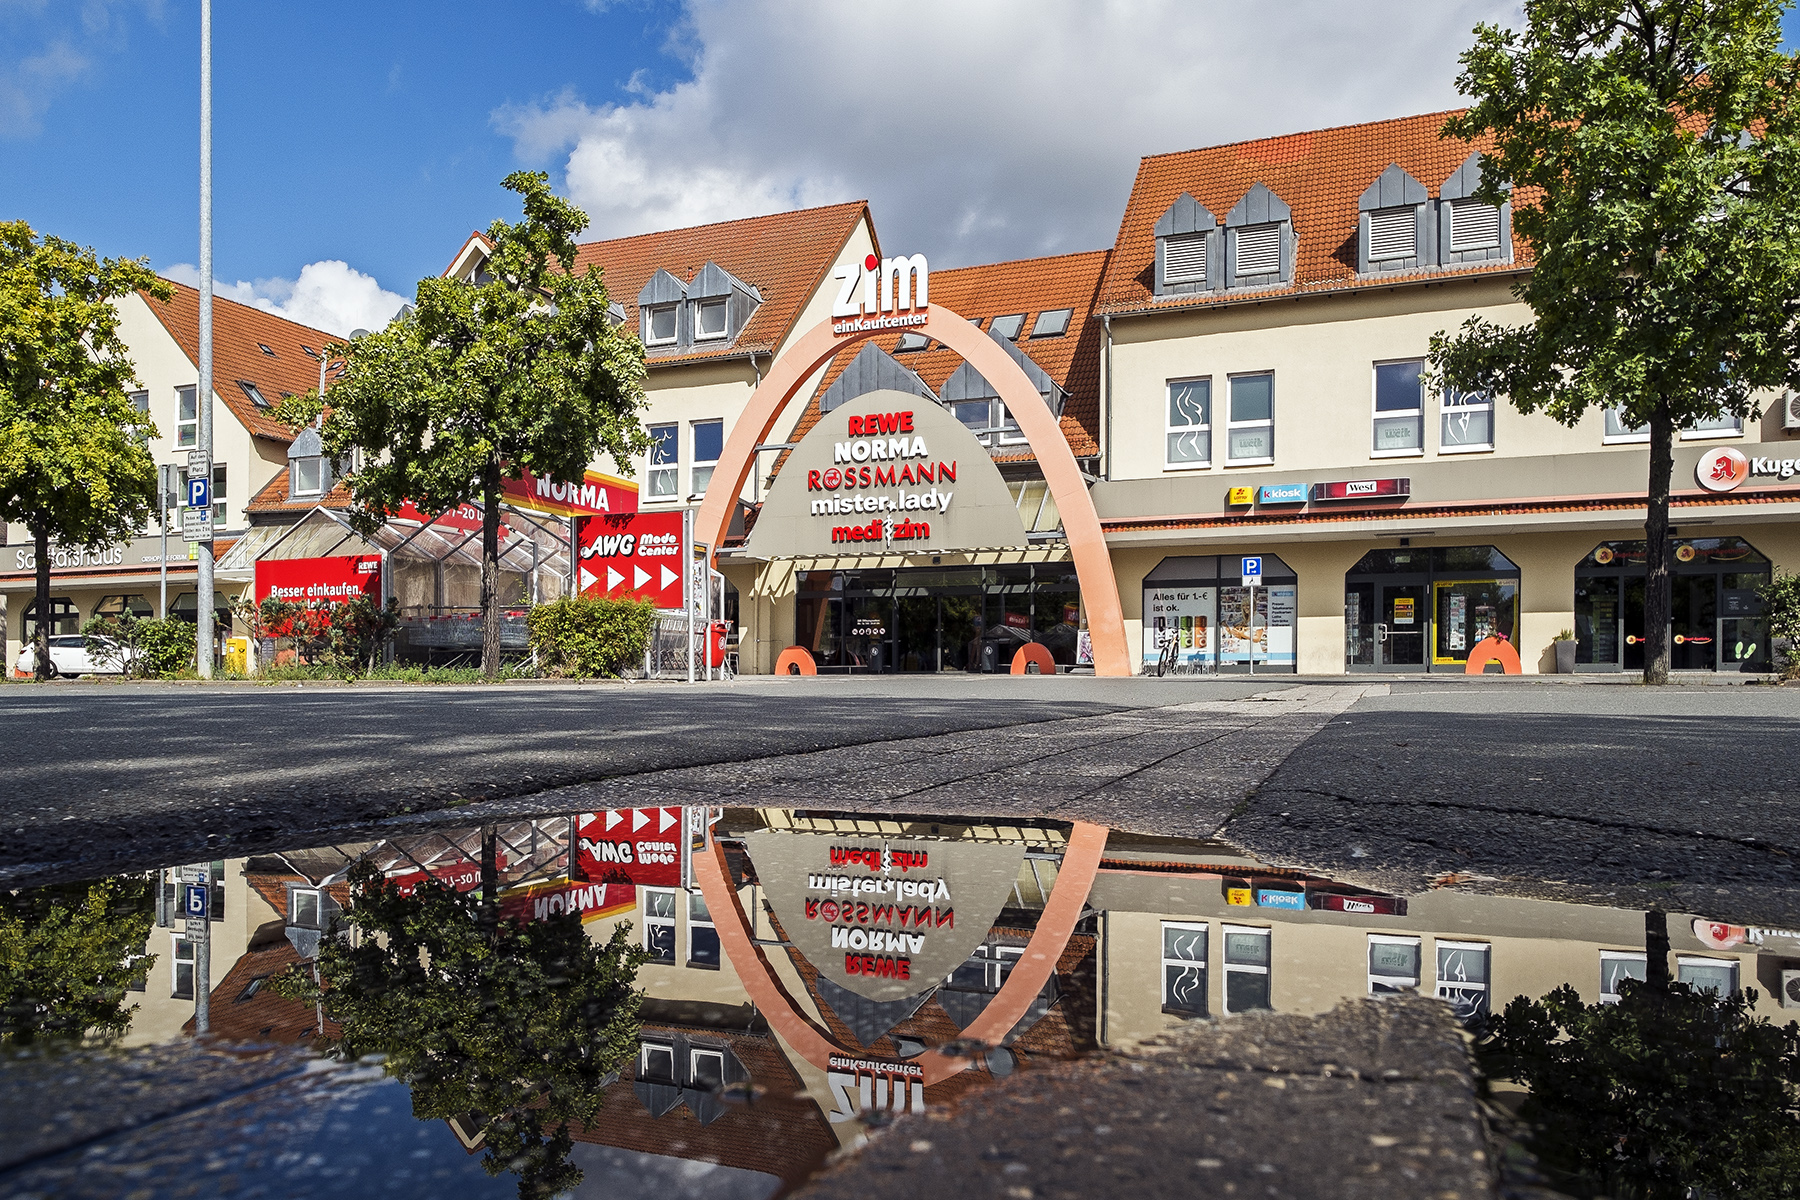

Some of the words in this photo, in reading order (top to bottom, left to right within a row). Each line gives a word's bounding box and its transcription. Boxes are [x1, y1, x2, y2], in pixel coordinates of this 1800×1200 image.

[833, 253, 928, 317] zim
[833, 313, 928, 334] einKaufcenter
[849, 411, 914, 437] REWE
[834, 436, 928, 464] NORMA
[808, 461, 957, 491] ROSSMANN
[192, 481, 205, 505] P
[537, 473, 610, 512] NORMA
[1271, 488, 1301, 498] kiosk
[1349, 482, 1375, 493] West
[811, 494, 889, 516] mister
[898, 488, 954, 515] lady
[832, 519, 882, 543] medi
[893, 517, 930, 541] zim
[580, 533, 637, 559] AWG
[639, 533, 677, 545] Mode
[637, 544, 679, 557] Center
[358, 561, 378, 570] REWE
[1246, 559, 1258, 575] P
[271, 585, 305, 598] Besser
[306, 582, 363, 597] einkaufen.
[1153, 593, 1175, 601] Alles
[1177, 592, 1190, 600] für
[1153, 604, 1164, 612] ist
[1166, 604, 1180, 612] ok.
